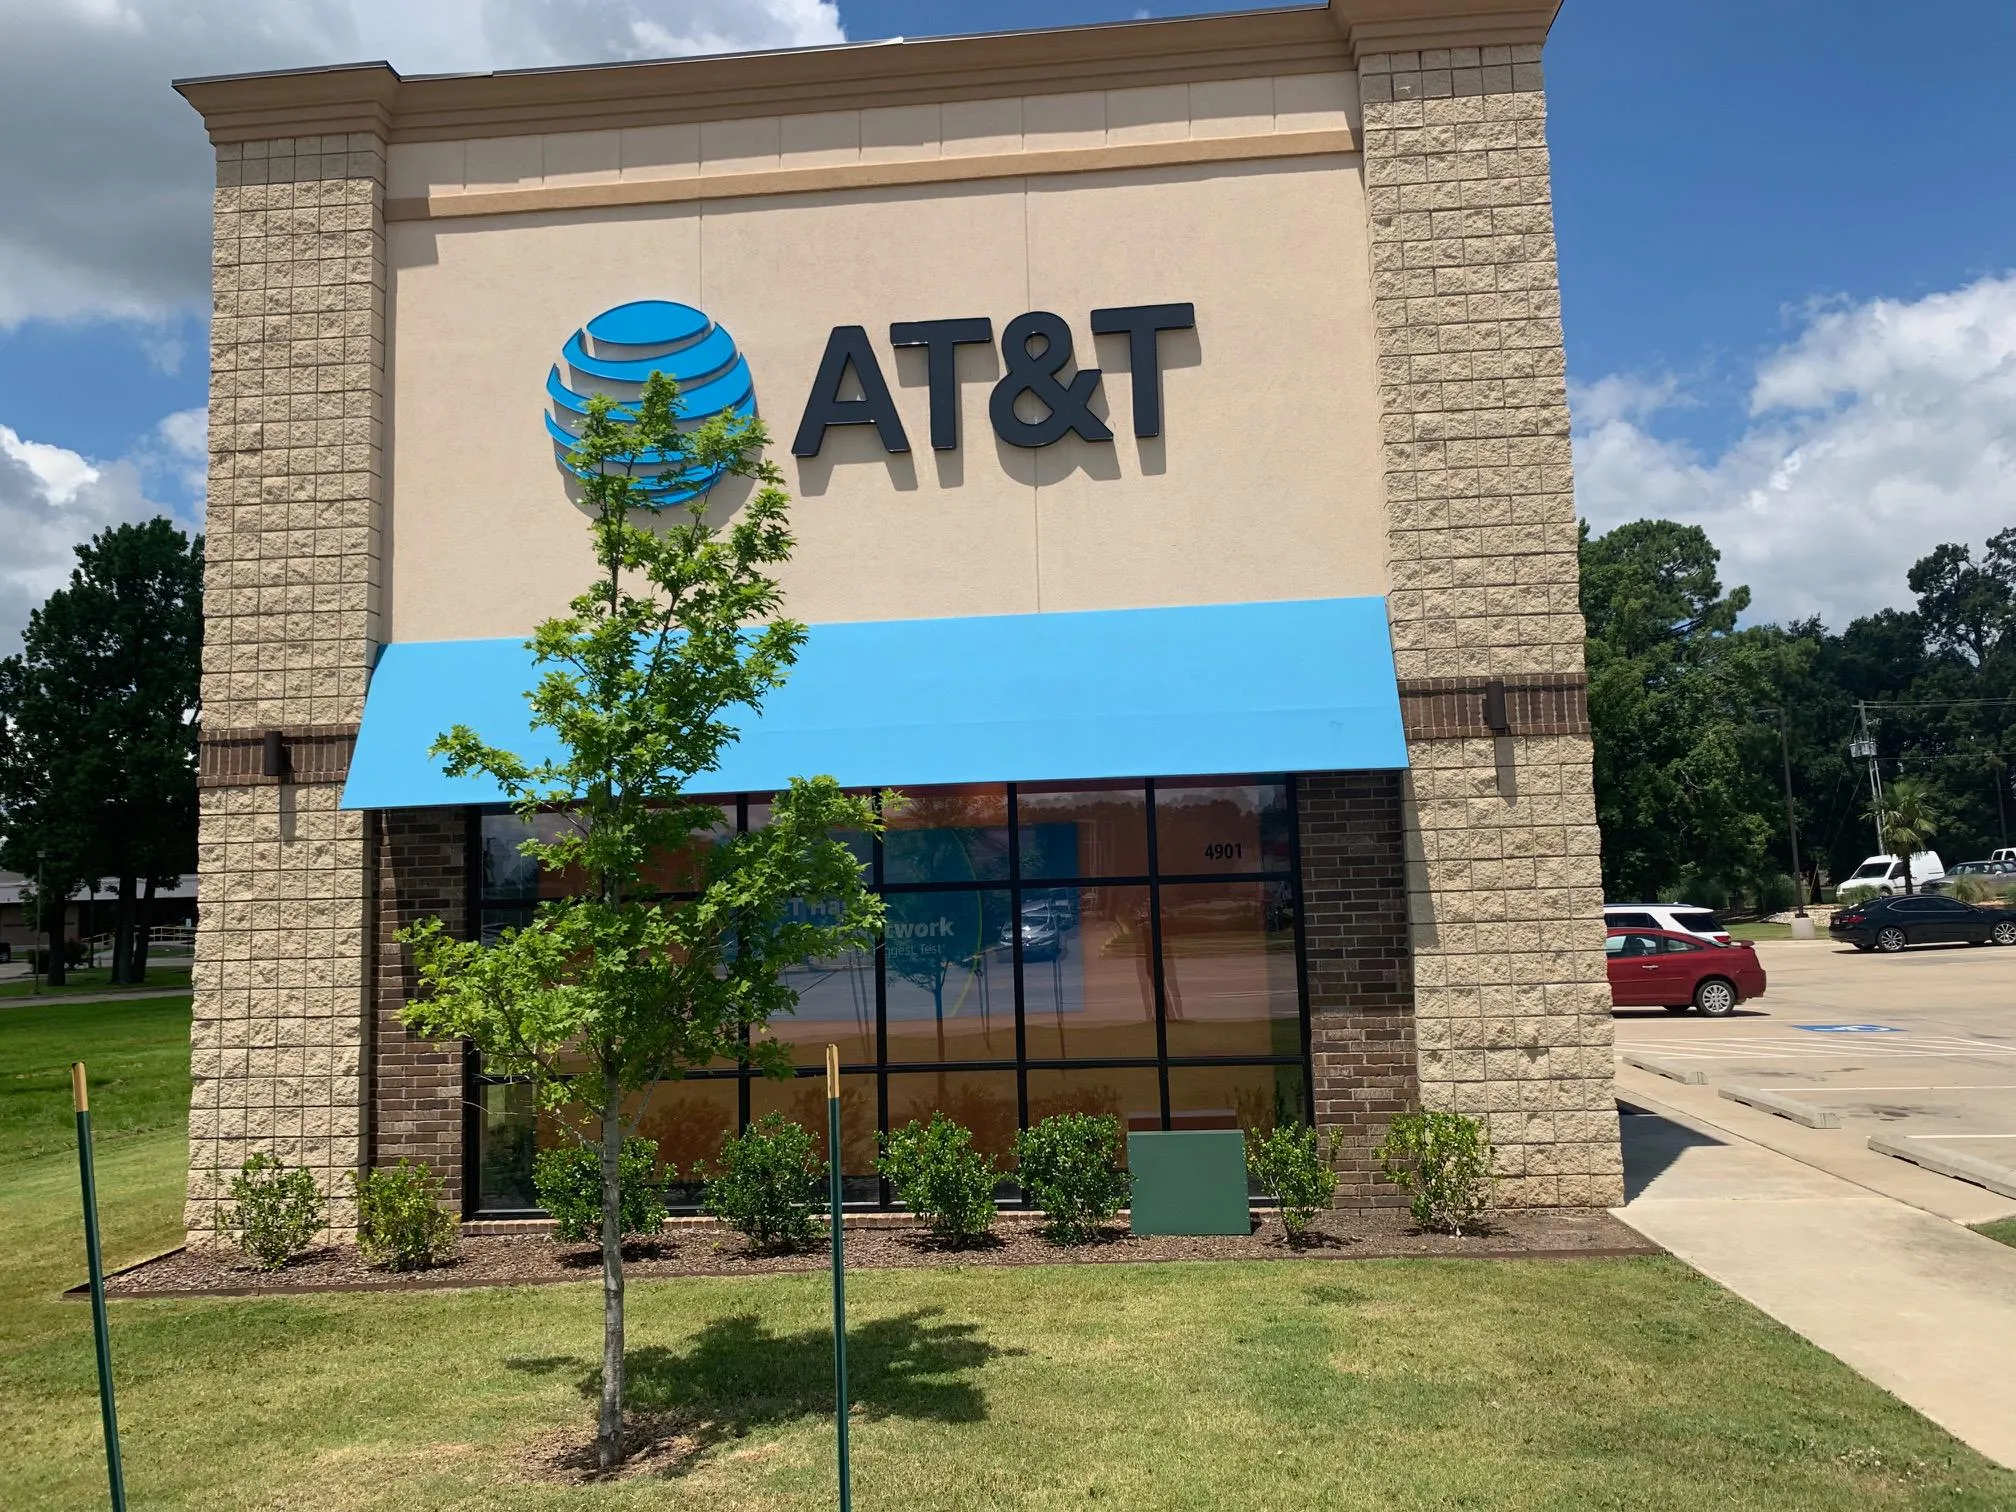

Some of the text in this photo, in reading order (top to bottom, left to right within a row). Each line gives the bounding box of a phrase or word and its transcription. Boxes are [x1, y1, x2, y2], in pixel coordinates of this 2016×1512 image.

[792, 303, 1195, 457] AT&T
[1204, 843, 1243, 860] 4901
[810, 898, 845, 916] Ha
[884, 916, 955, 939] twork
